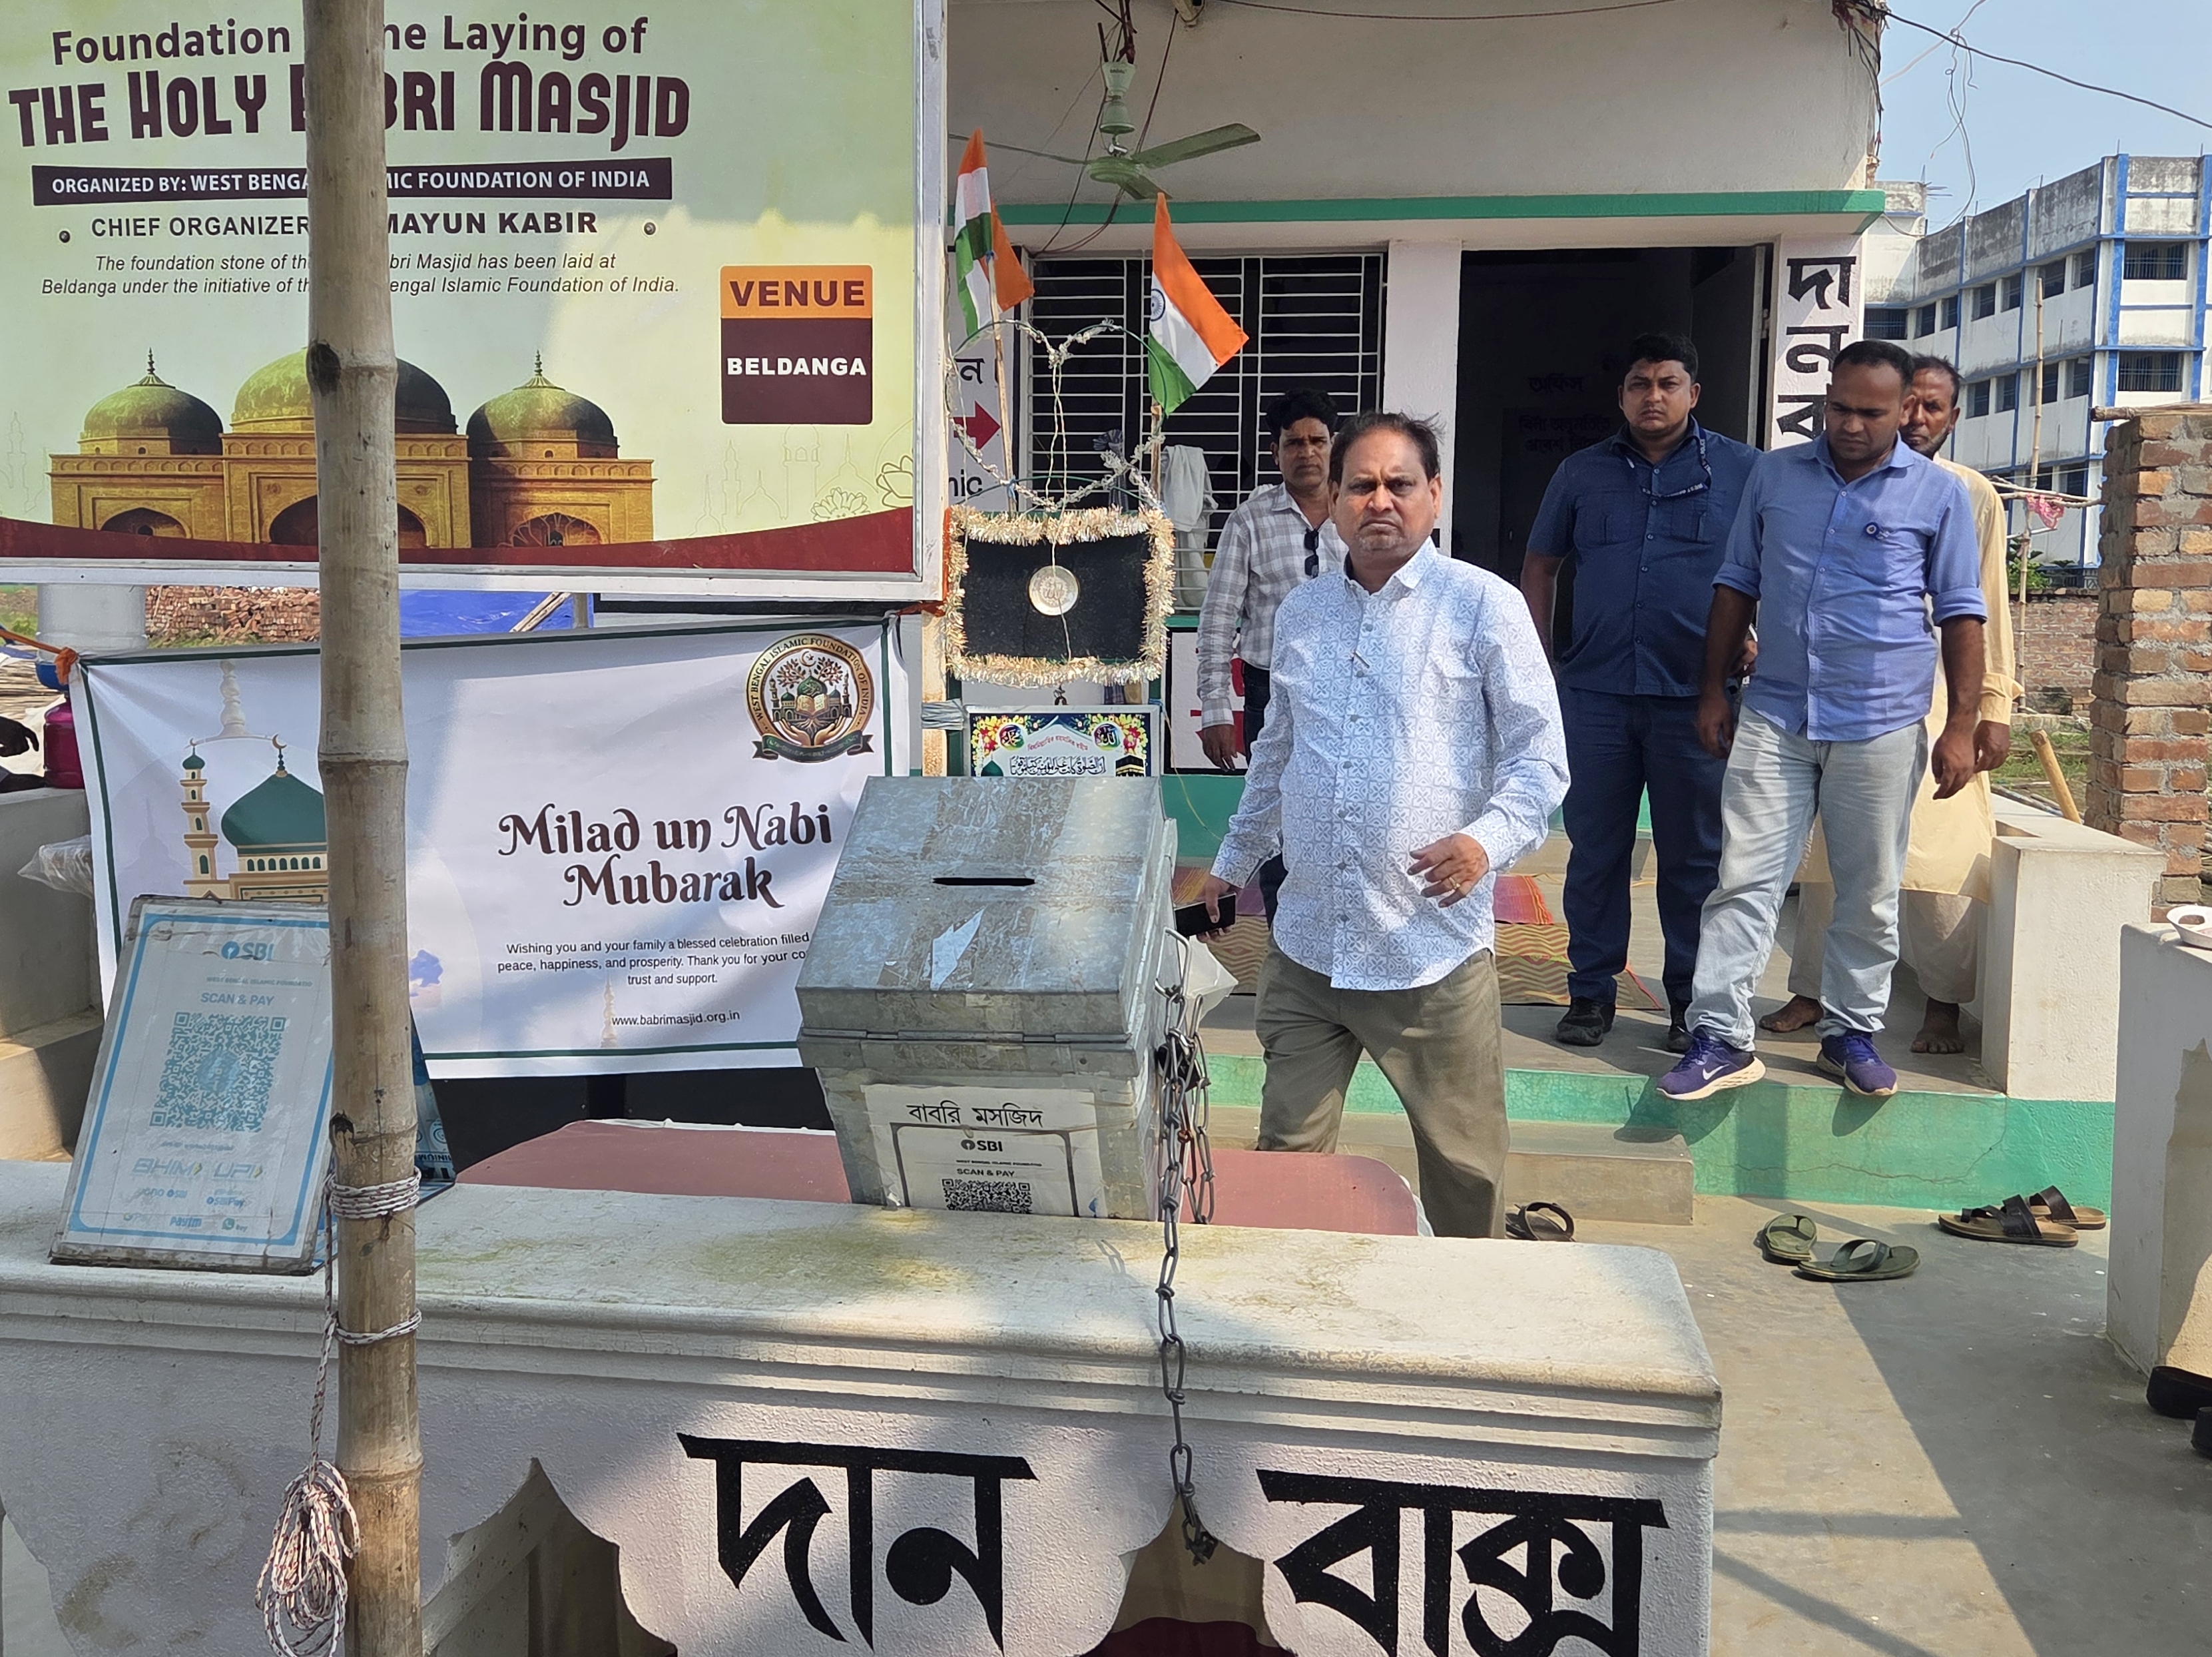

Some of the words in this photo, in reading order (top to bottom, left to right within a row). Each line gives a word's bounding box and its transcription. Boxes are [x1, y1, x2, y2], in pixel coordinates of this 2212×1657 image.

[53, 18, 290, 65] Foundation
[444, 13, 585, 61] Laying
[602, 17, 648, 54] of
[9, 83, 109, 147] THE
[127, 70, 267, 139] HOLY
[480, 61, 690, 152] MASJID
[52, 176, 154, 194] ORGANIZED
[159, 176, 186, 192] BY:
[190, 174, 242, 192] WEST
[418, 171, 553, 189] FOUNDATION
[558, 170, 585, 188] OF
[591, 170, 650, 188] INDIA
[91, 217, 160, 237] CHIEF
[169, 215, 309, 236] ORGANIZER
[387, 212, 486, 234] MAYUN
[498, 211, 598, 234] KABIR
[96, 255, 125, 271] The
[131, 254, 214, 271] foundation
[220, 256, 264, 270] stone
[270, 254, 288, 270] of
[292, 254, 307, 270] th
[389, 252, 412, 270] bri
[417, 252, 472, 273] Masjid
[477, 253, 507, 270] has
[513, 253, 556, 270] been
[562, 252, 593, 270] laid
[599, 253, 616, 270] at
[41, 278, 117, 298] Beldanga
[122, 278, 168, 294] under
[173, 278, 198, 294] the
[203, 276, 270, 293] initiative
[276, 276, 294, 293] of
[390, 276, 435, 296] engal
[441, 276, 501, 293] Islamic
[507, 276, 605, 293] Foundation
[610, 276, 627, 293] of
[633, 276, 680, 292] India.
[729, 280, 865, 307] VENUE
[726, 357, 867, 376] BELDANGA
[770, 637, 808, 659] ISLAMIC
[810, 638, 862, 673] FOUNDATION
[750, 657, 771, 694] BENGAL
[858, 673, 869, 685] OF
[750, 695, 764, 721] WEST
[859, 687, 870, 716] INDIA
[498, 803, 641, 856] Milad
[653, 819, 711, 852] un
[720, 802, 832, 851] Nabi
[563, 854, 785, 908] Mubarak
[242, 942, 274, 961] SBI
[506, 942, 553, 955] Wishing
[555, 943, 577, 954] you
[580, 940, 602, 952] and
[605, 941, 630, 953] your
[633, 939, 666, 952] family
[668, 940, 675, 950] a
[677, 937, 716, 949] blessed
[719, 934, 778, 948] celebration
[780, 932, 810, 945] filled
[497, 961, 537, 974] peace,
[539, 958, 602, 972] happiness,
[605, 957, 627, 968] and
[629, 956, 684, 970] prosperity.
[687, 954, 719, 966] Thank
[721, 954, 740, 968] you
[744, 952, 758, 964] for
[760, 951, 788, 966] your
[791, 950, 806, 960] co
[627, 974, 652, 985] trust
[654, 973, 674, 984] and
[676, 973, 718, 986] support.
[200, 992, 235, 1004] SCAN
[236, 994, 247, 1005] &
[249, 994, 275, 1006] PAY
[611, 1010, 740, 1026] www.babrimasjid.org.in
[906, 1100, 962, 1124] বাবরি
[971, 1102, 1043, 1128] মসজিদ
[976, 1140, 1003, 1152] SBI
[132, 1158, 198, 1177] BHIM
[214, 1161, 256, 1178] UPI
[995, 1169, 1015, 1177] PAY
[677, 1432, 1039, 1657] দান
[1256, 1469, 1670, 1657] বাক্স
